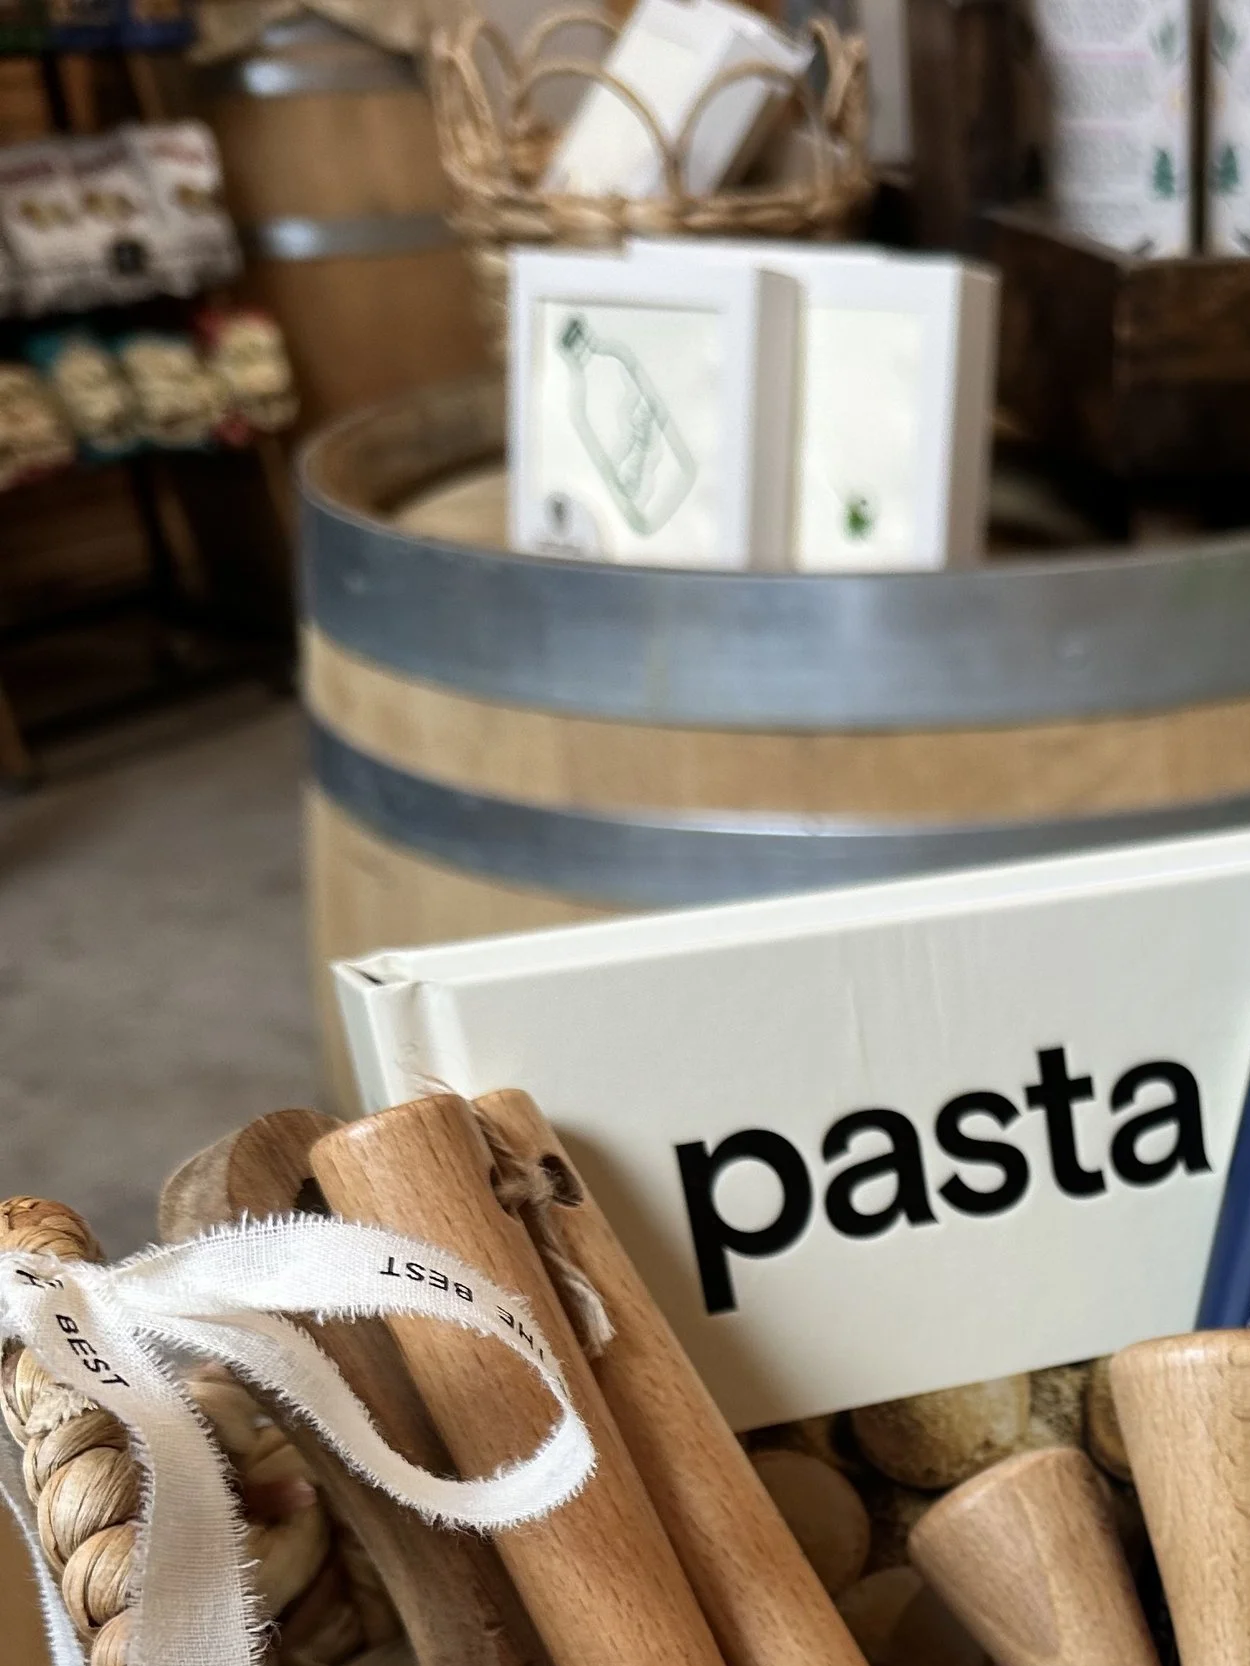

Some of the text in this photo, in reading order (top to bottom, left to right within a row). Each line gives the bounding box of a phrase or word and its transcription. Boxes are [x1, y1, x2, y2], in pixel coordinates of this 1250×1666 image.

[675, 1045, 1214, 1316] pasta
[379, 1255, 474, 1303] BEST
[55, 1313, 131, 1388] BEST
